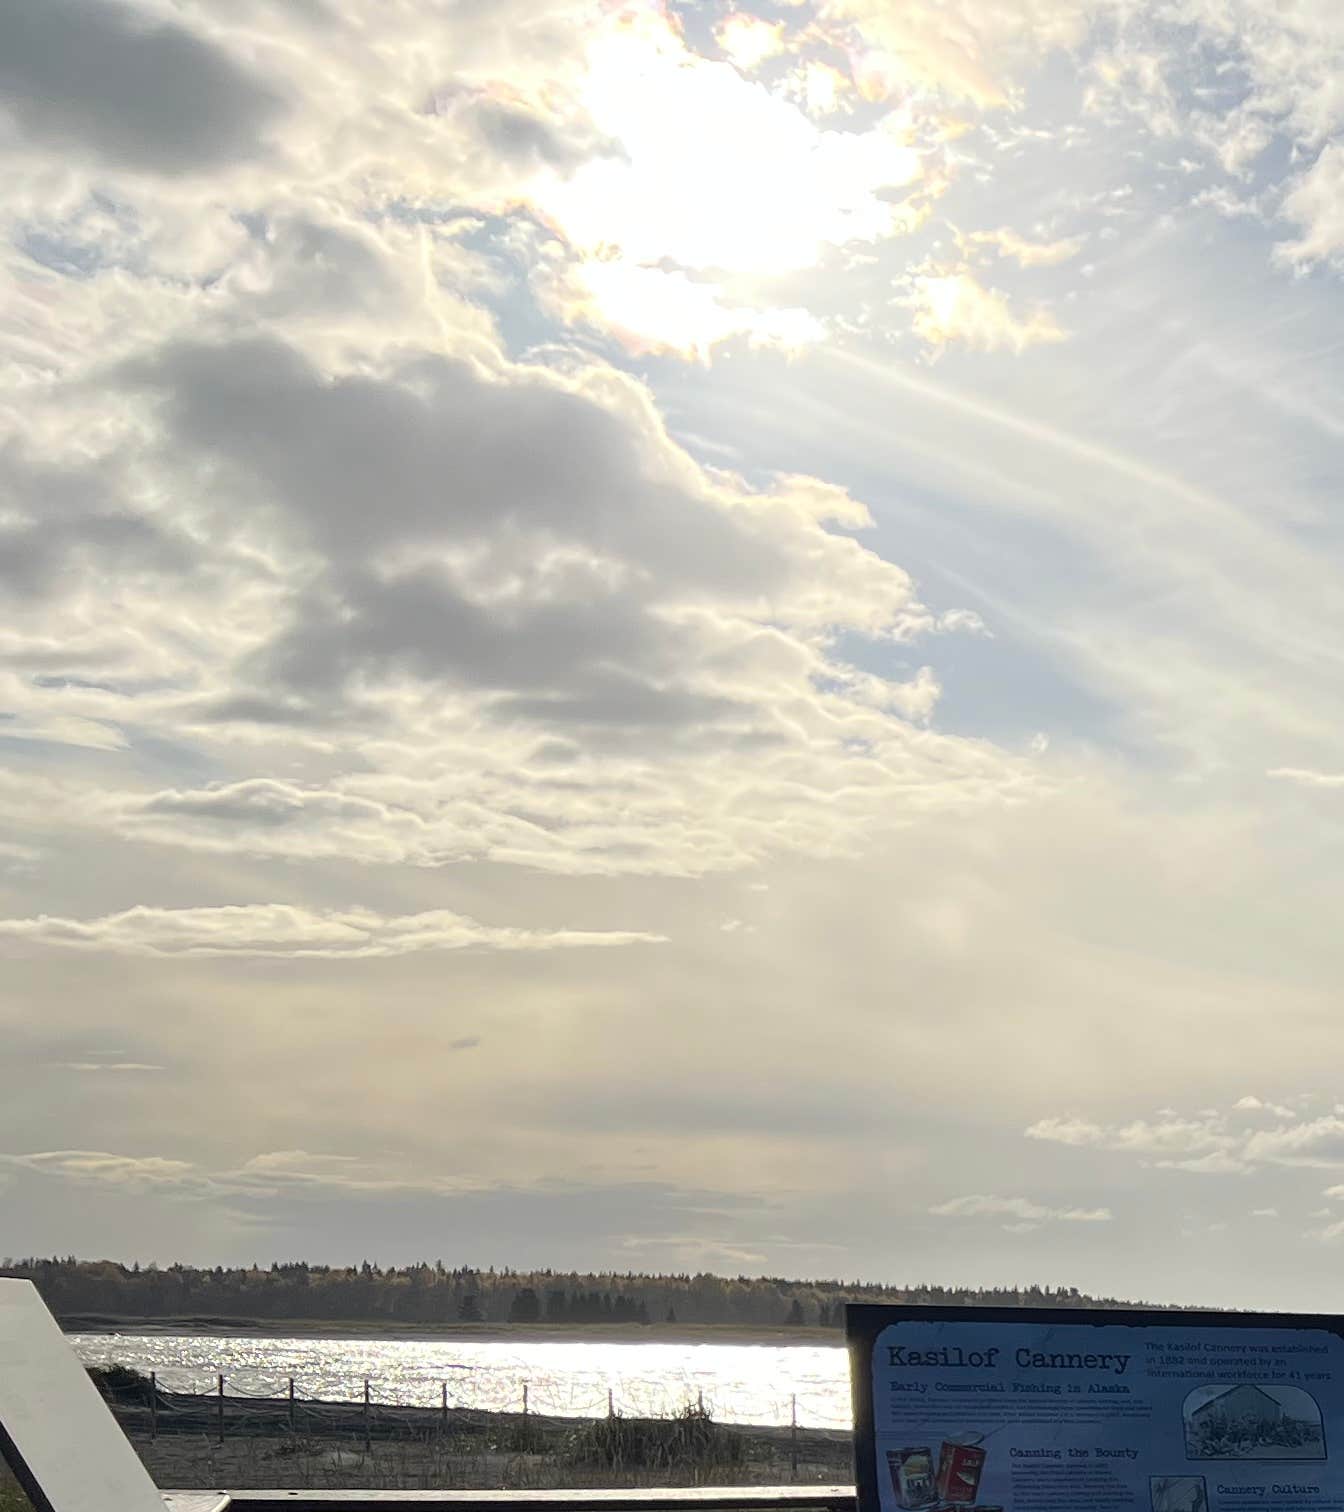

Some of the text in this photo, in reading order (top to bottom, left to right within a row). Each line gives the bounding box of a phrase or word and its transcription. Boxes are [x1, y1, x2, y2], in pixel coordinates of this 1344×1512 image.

[888, 1345, 1132, 1375] Kasilof Cannery
[889, 1381, 1131, 1395] Early Commercial Fishing in Alaska
[1009, 1448, 1139, 1460] Canning the Bounty
[1216, 1484, 1320, 1496] Cannery Culture
